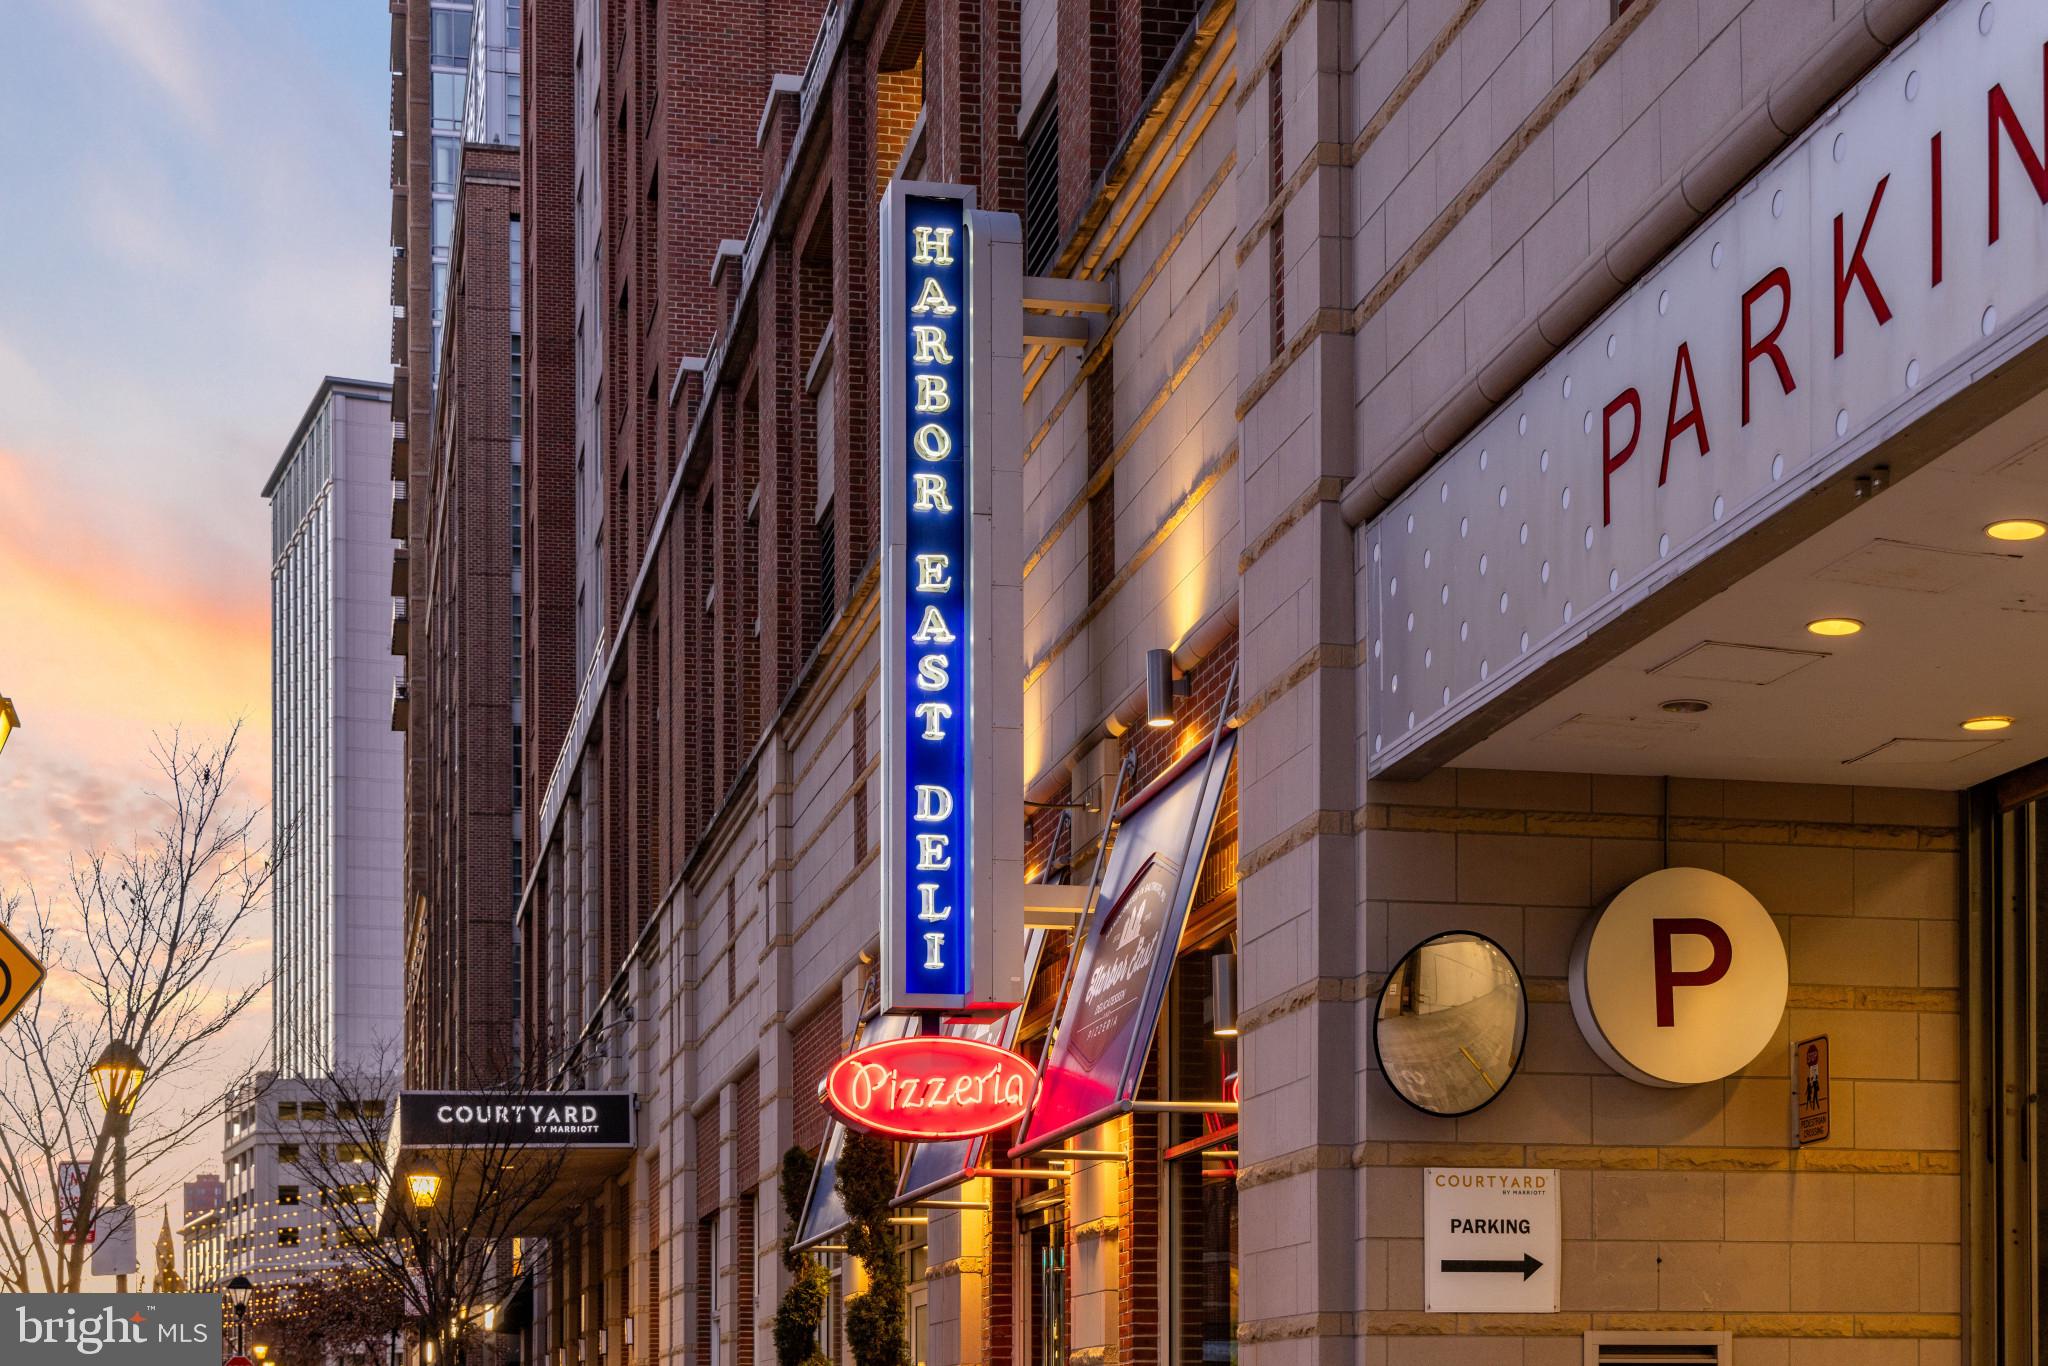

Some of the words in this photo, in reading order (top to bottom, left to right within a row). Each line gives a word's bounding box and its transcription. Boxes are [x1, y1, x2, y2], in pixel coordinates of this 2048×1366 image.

[911, 224, 957, 515] HARBOR
[911, 553, 956, 741] EAST
[912, 783, 954, 971] DELI
[1085, 956, 1128, 1006] Harbor
[1126, 931, 1159, 981] East
[1653, 917, 1733, 1028] P
[1086, 1015, 1119, 1040] PIZZERIA
[849, 1060, 1024, 1111] Pizzeria
[437, 1105, 597, 1123] COURTYARD
[1801, 1115, 1826, 1129] PEDESTRIAN
[535, 1125, 546, 1133] BY
[550, 1125, 599, 1133] MARRIOTT
[1803, 1126, 1825, 1138] CROSSING
[1435, 1174, 1546, 1189] COURTYARD
[1450, 1218, 1531, 1234] PARKING
